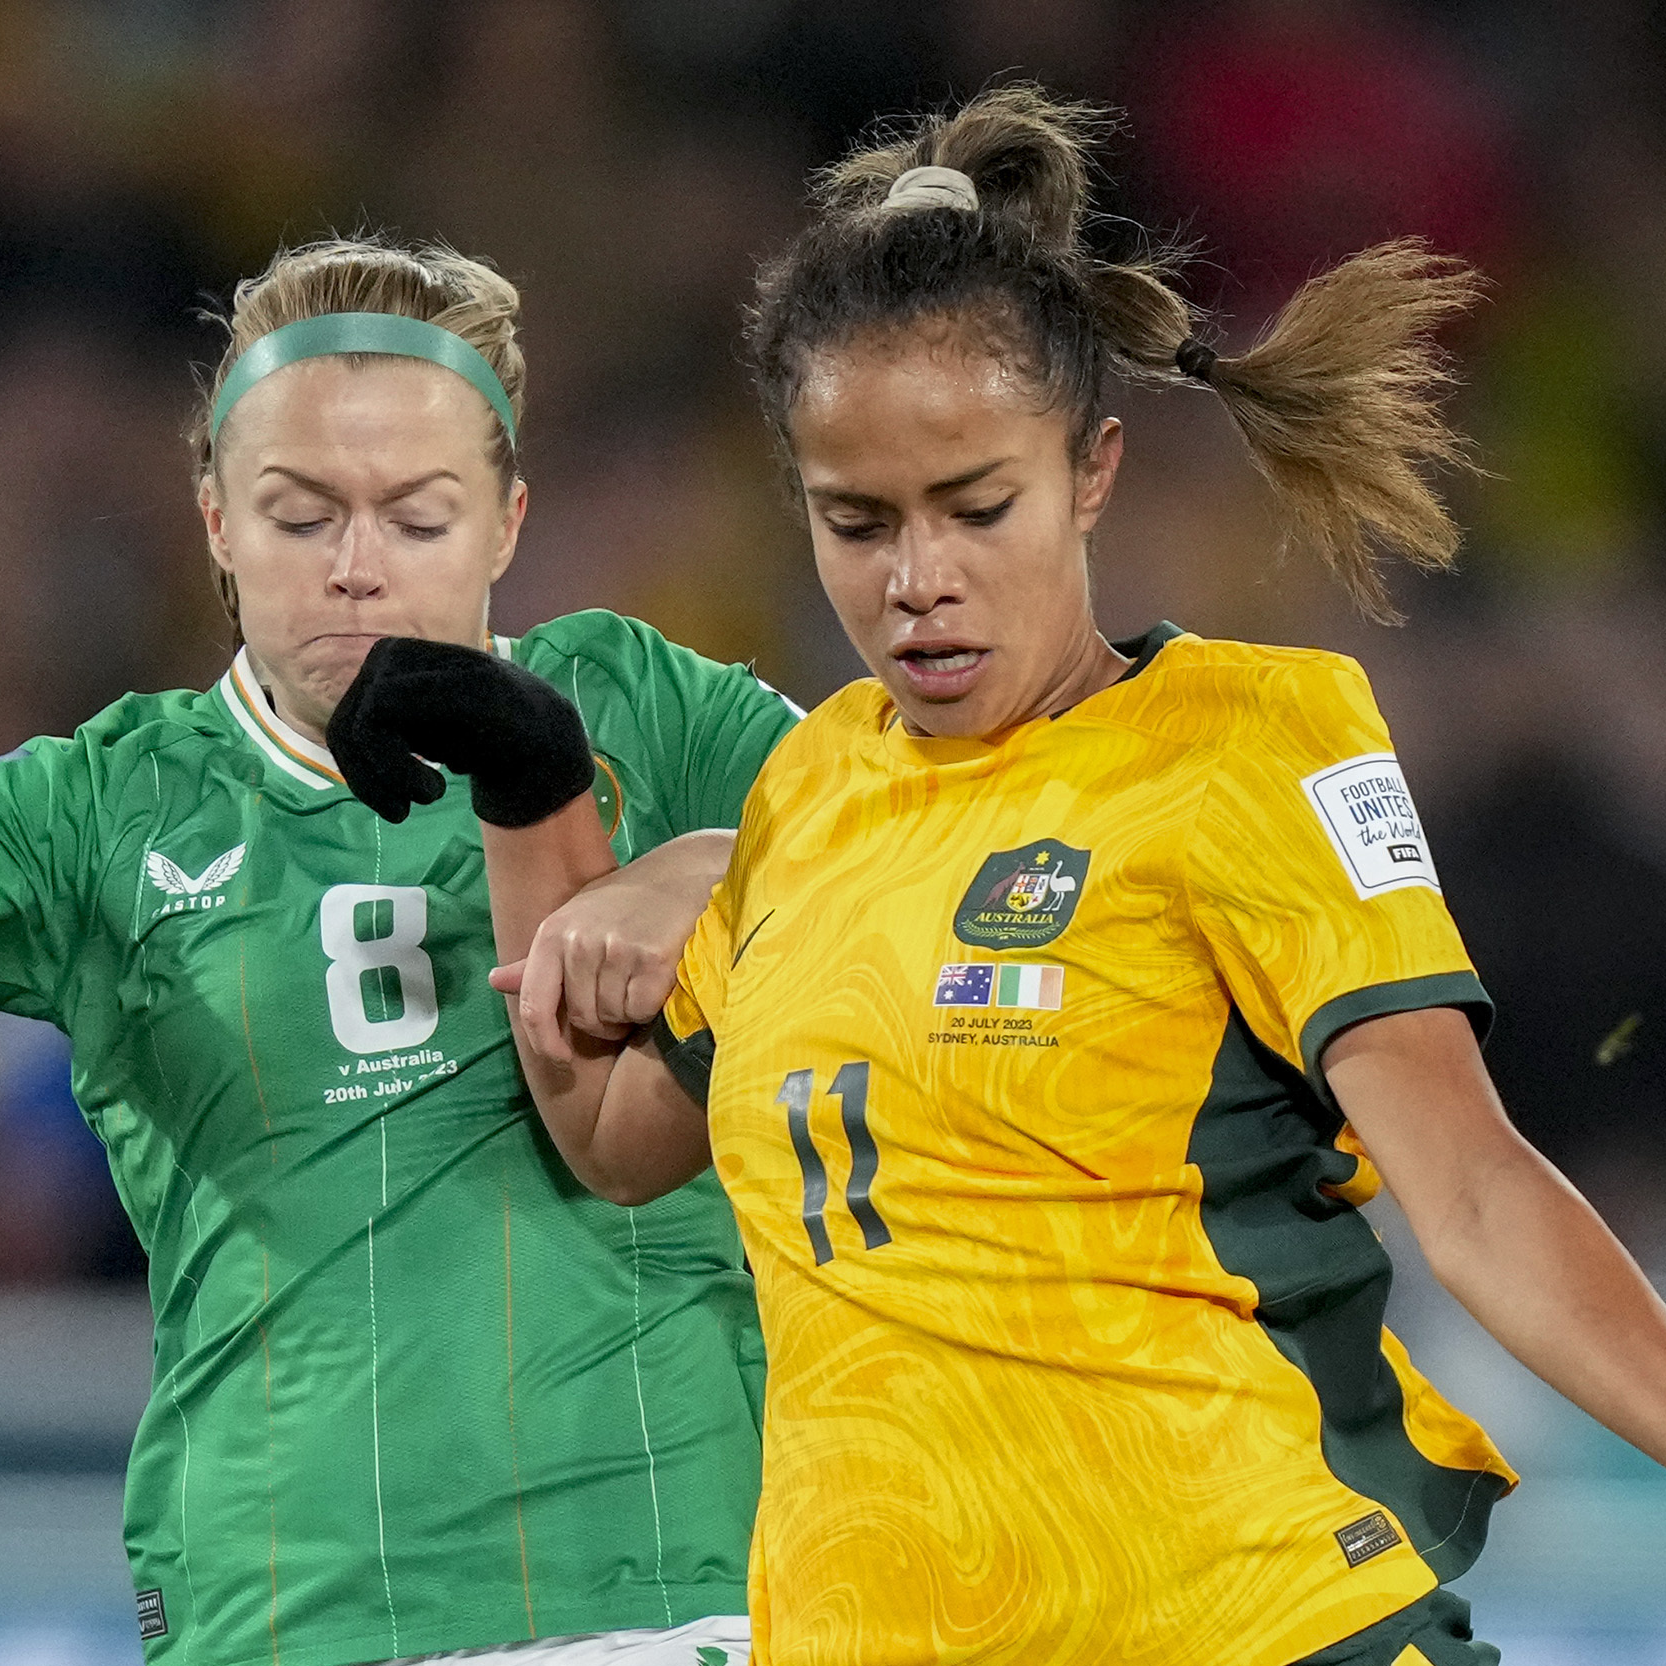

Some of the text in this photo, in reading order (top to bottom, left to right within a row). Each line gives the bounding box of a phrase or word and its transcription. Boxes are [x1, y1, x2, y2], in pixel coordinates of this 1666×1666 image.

[1340, 777, 1406, 803] FOOTBALL
[1348, 795, 1414, 825] UNITES
[1357, 821, 1421, 846] the World
[1391, 847, 1420, 860] FIFA
[974, 911, 1054, 924] AUSTRALIA
[320, 884, 439, 1054] 8
[951, 1017, 1033, 1030] 20 JULY 2023
[928, 1032, 1059, 1048] SYDNEY, AUSTRALIA
[338, 1049, 444, 1076] v Australia
[323, 1059, 459, 1104] 20th July 23
[774, 1060, 893, 1267] 11
